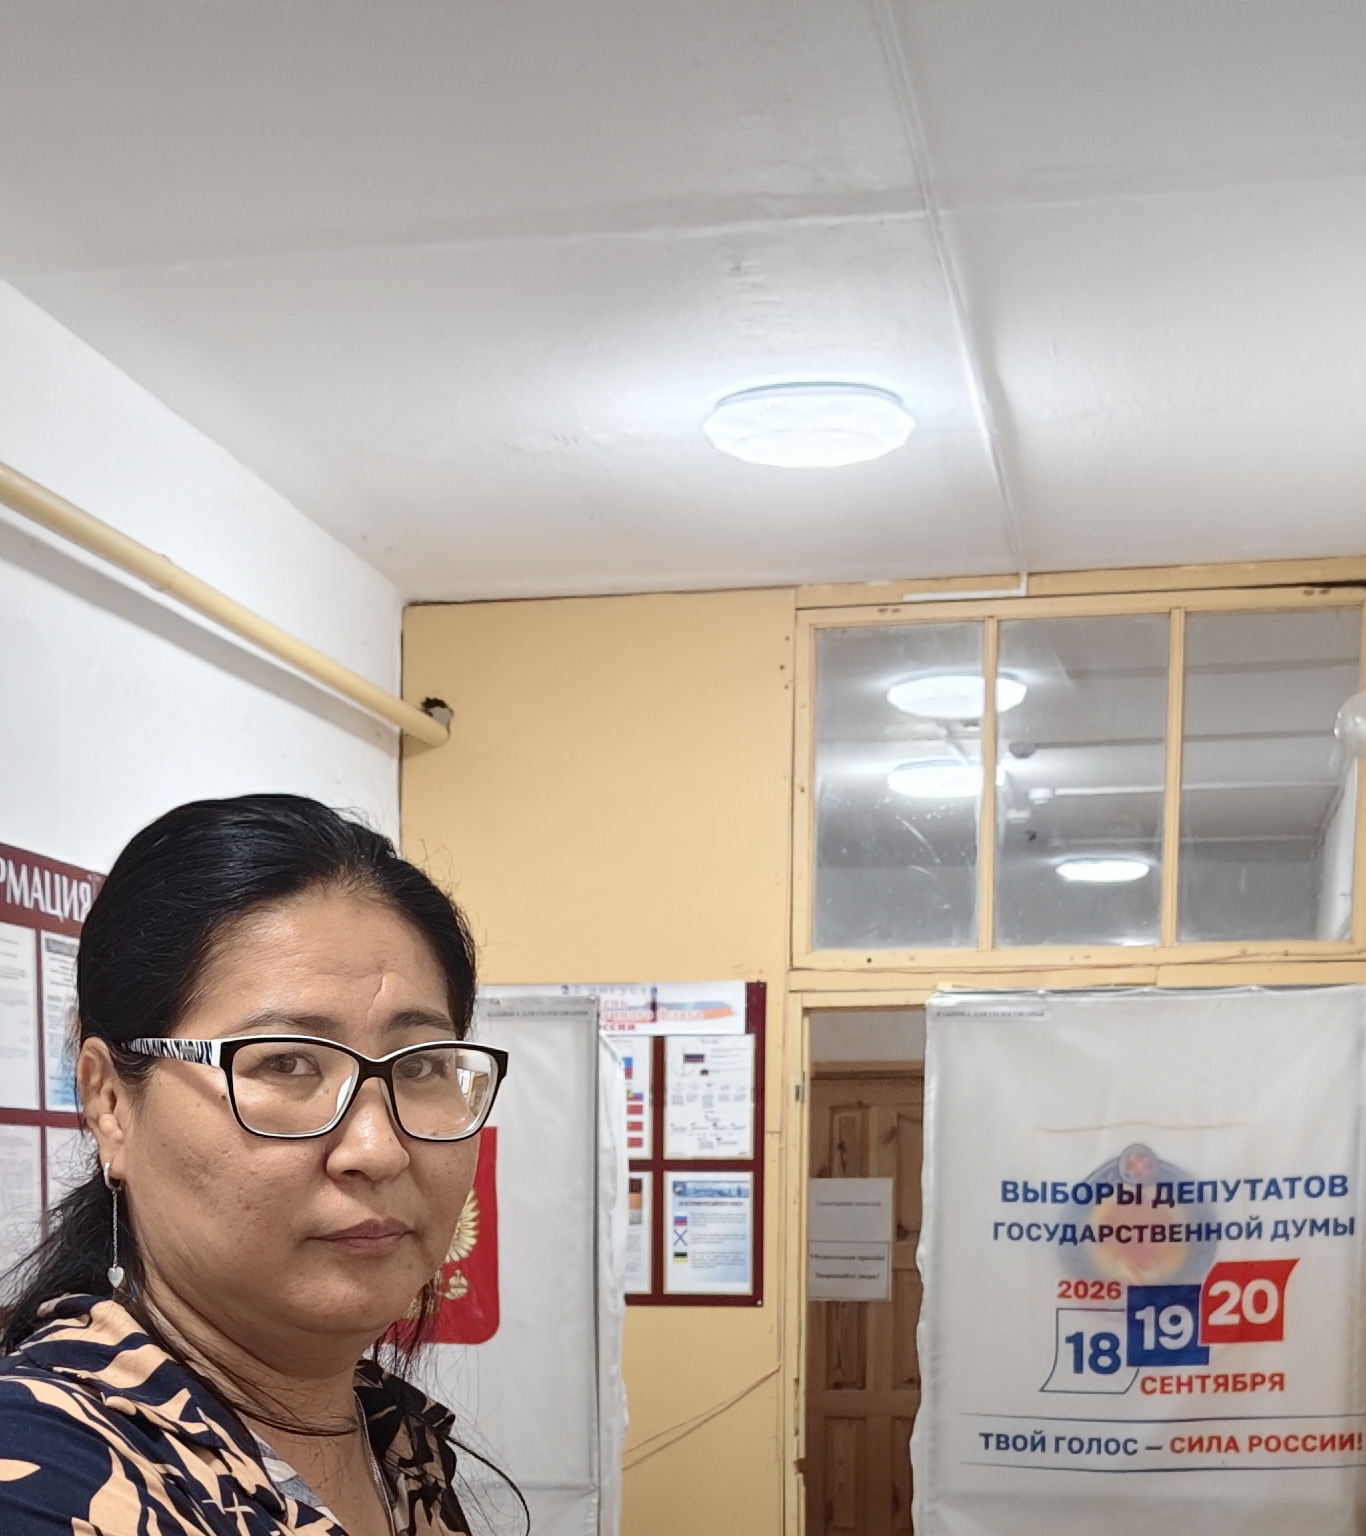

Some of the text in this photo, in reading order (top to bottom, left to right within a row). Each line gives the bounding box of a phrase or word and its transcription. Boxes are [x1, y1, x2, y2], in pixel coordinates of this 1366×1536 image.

[1001, 1175, 1349, 1209] ВЫБОРЫ ДЕПУТАТОВ
[992, 1216, 1355, 1246] ГОСУДАРСТВЕННОЙ ДУМЫ
[1057, 1279, 1122, 1300] 2026
[1065, 1278, 1279, 1376] 18 19 20
[1140, 1372, 1285, 1395] СЕНТЯБРЯ
[979, 1429, 1046, 1453] ТВОЙ
[1053, 1435, 1139, 1457] ГОЛОС
[1169, 1434, 1240, 1455] СИЛА
[1248, 1432, 1363, 1453] РОССИИ!
